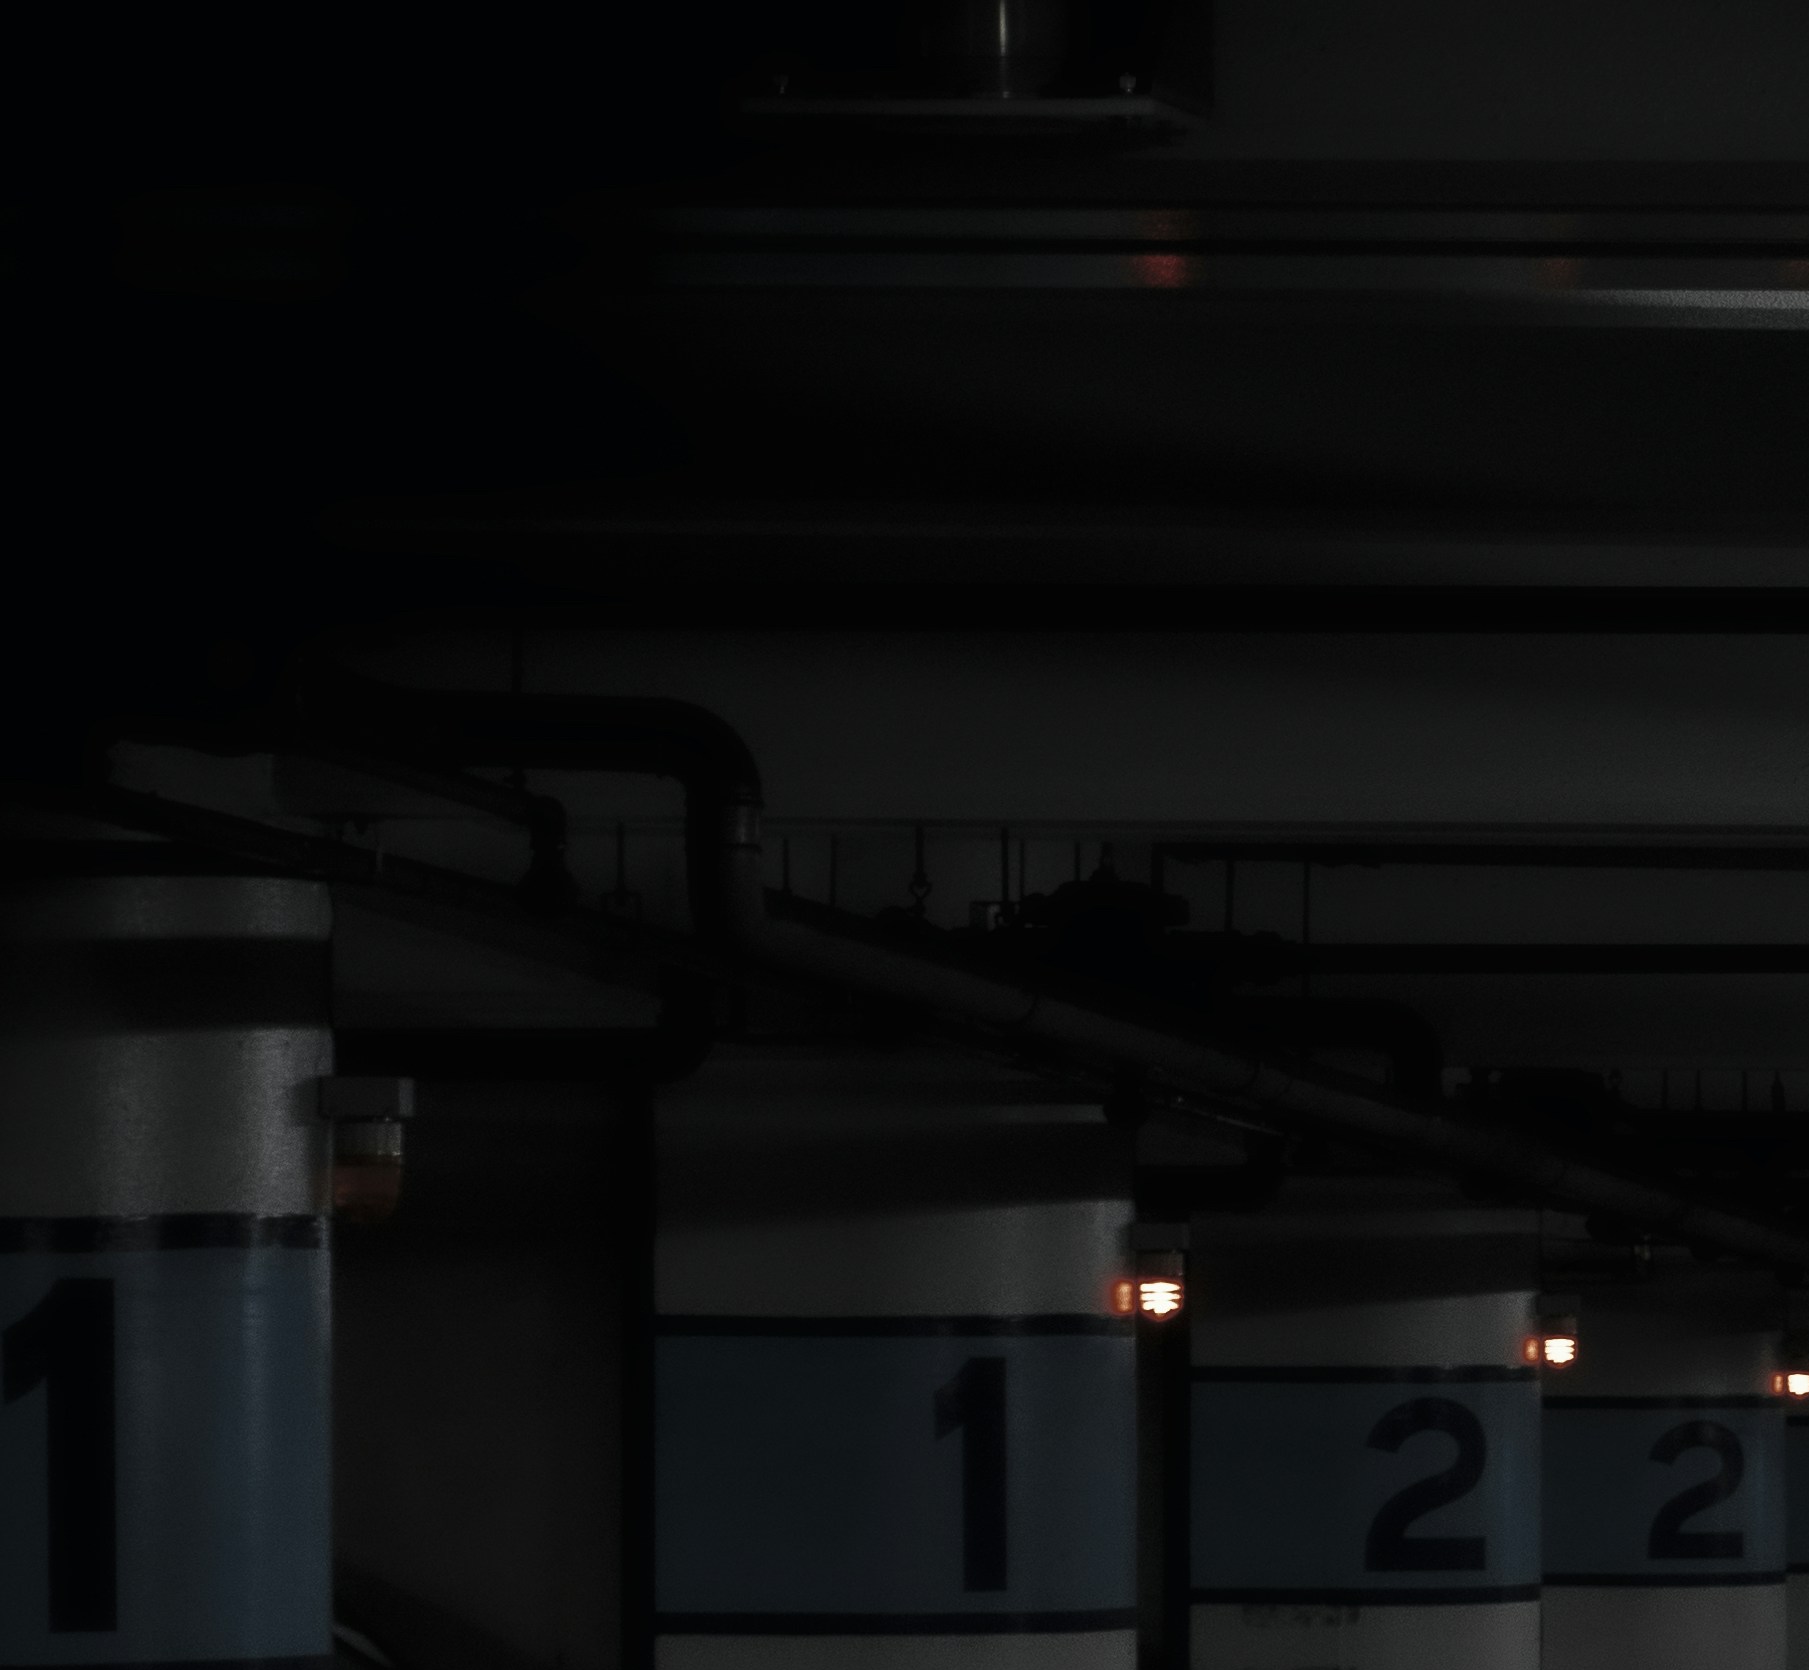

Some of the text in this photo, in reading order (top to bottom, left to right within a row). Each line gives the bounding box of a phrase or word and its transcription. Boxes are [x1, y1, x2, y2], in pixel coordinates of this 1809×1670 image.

[0, 1277, 117, 1632] 1
[933, 1356, 1007, 1591] 1
[1365, 1398, 1487, 1571] 2
[1647, 1420, 1744, 1559] 2
